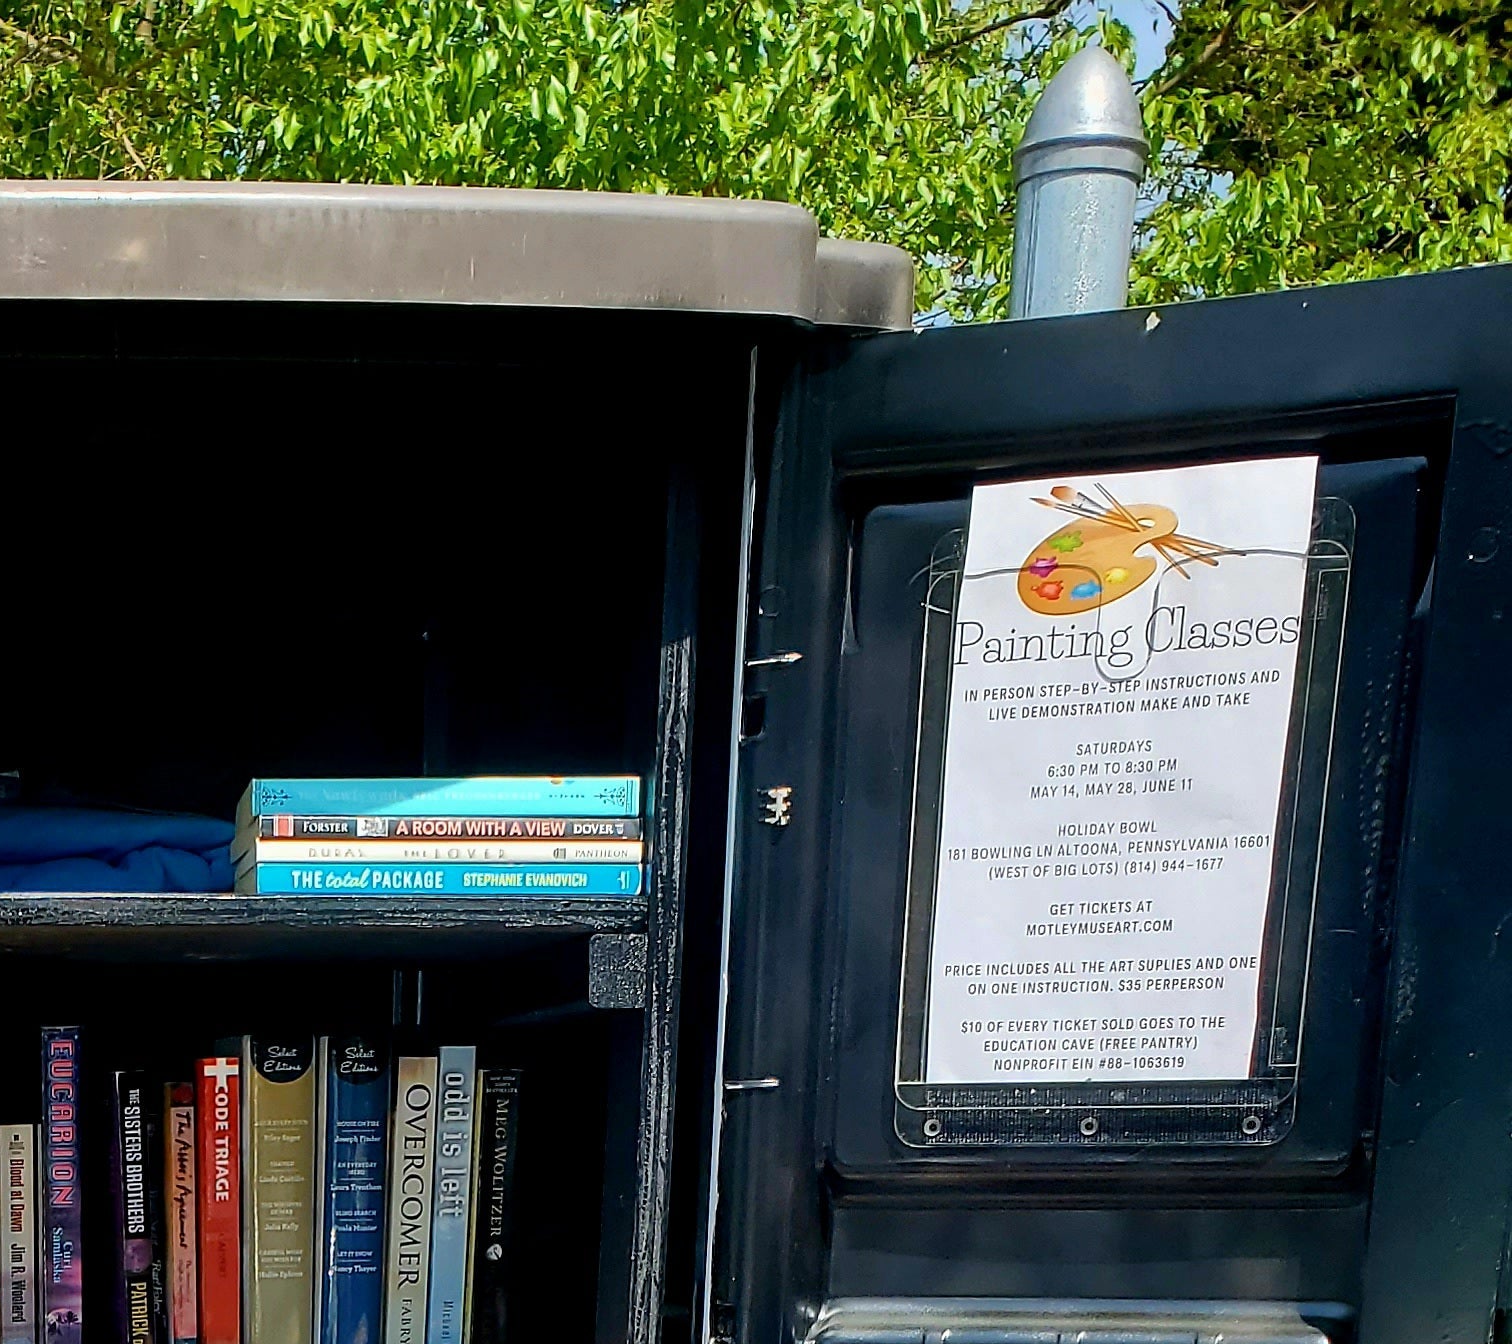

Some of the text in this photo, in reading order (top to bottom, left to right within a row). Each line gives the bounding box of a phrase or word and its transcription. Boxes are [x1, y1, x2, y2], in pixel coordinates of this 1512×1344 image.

[955, 606, 1300, 668] Painting Classes
[964, 670, 1280, 702] IN PERSON STEP-BY-STEP INSTRUCTIONS AND
[989, 692, 1251, 721] LIVE DEMONSTRATION MAKE AND TAKE
[1075, 740, 1152, 755] SATURDAYS
[1047, 758, 1177, 777] 6:30 PM TO 8:30 PM
[1030, 778, 1193, 798] MAY 14, MAY 28, JUNE 11
[302, 820, 348, 833] FORSTER
[396, 821, 566, 836] A ROOM WITH A VIEW
[573, 824, 613, 835] DOVER
[1058, 821, 1157, 837] HOLIDAY BOWL
[947, 835, 1271, 860] 181 BOWLING LN ALTOONA, PENNSYLVANIA 16601
[292, 867, 444, 888] THE total PACKAGE
[988, 858, 1224, 880] (WEST OF BIG LOTS) (814) 944-1677
[463, 873, 587, 887] STEPHANIE EVANOVICH
[1049, 901, 1153, 915] GET TICKETS AT
[1026, 920, 1173, 936] MOTLEYMUSEART.COM
[944, 956, 1258, 976] PRICE INCLUDES ALL THE ART SUPLIES AND ONE
[967, 977, 1225, 994] ON ONE INSTRUCTION. $35 PERPERSON
[960, 1016, 1226, 1034] $10 OF EVERY TICKET SOLD GOES TO THE
[983, 1036, 1198, 1051] EDUCATION CAVE (FREE PANTRY)
[993, 1057, 1185, 1070] NONPROFIT EIN #88-1063619
[50, 1040, 75, 1207] EUCARION
[214, 1084, 229, 1201] CODE TRIAGE
[438, 1073, 469, 1217] odd is left
[125, 1089, 145, 1233] THE SISTERS BROTHERS
[489, 1099, 509, 1237] MEG WOLITZER
[397, 1084, 432, 1289] OVERCOMER
